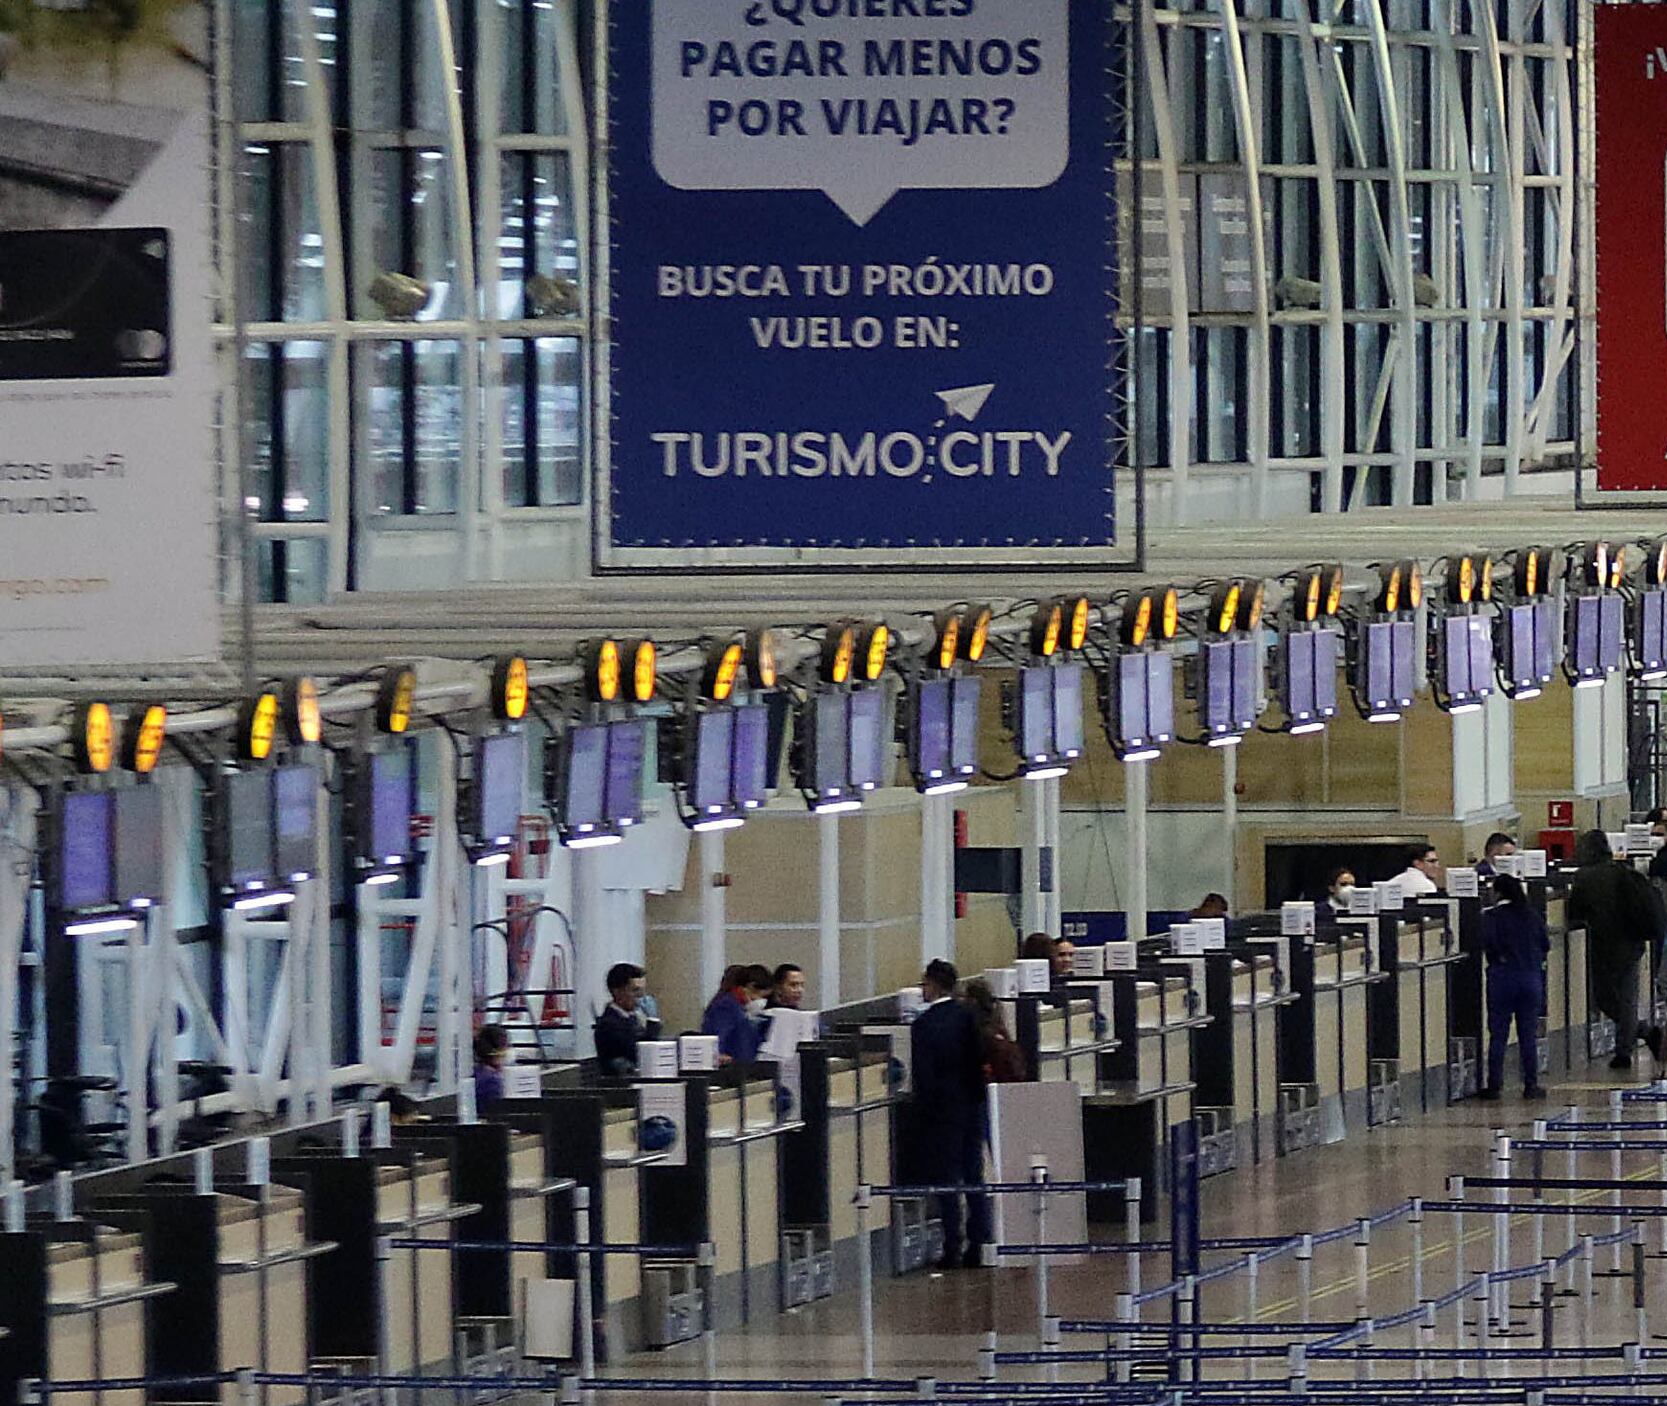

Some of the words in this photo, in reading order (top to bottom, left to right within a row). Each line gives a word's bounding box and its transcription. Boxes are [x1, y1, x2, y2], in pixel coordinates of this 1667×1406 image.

[680, 40, 848, 77] PAGAR
[864, 38, 1042, 77] MENOS
[707, 99, 808, 137] POR
[821, 97, 1017, 146] VIAJAR?
[657, 265, 789, 297] BUSCA
[798, 265, 851, 296] TU
[863, 256, 1055, 296] PRÓXIMO
[751, 316, 883, 349] VUELO
[893, 316, 961, 348] EN:
